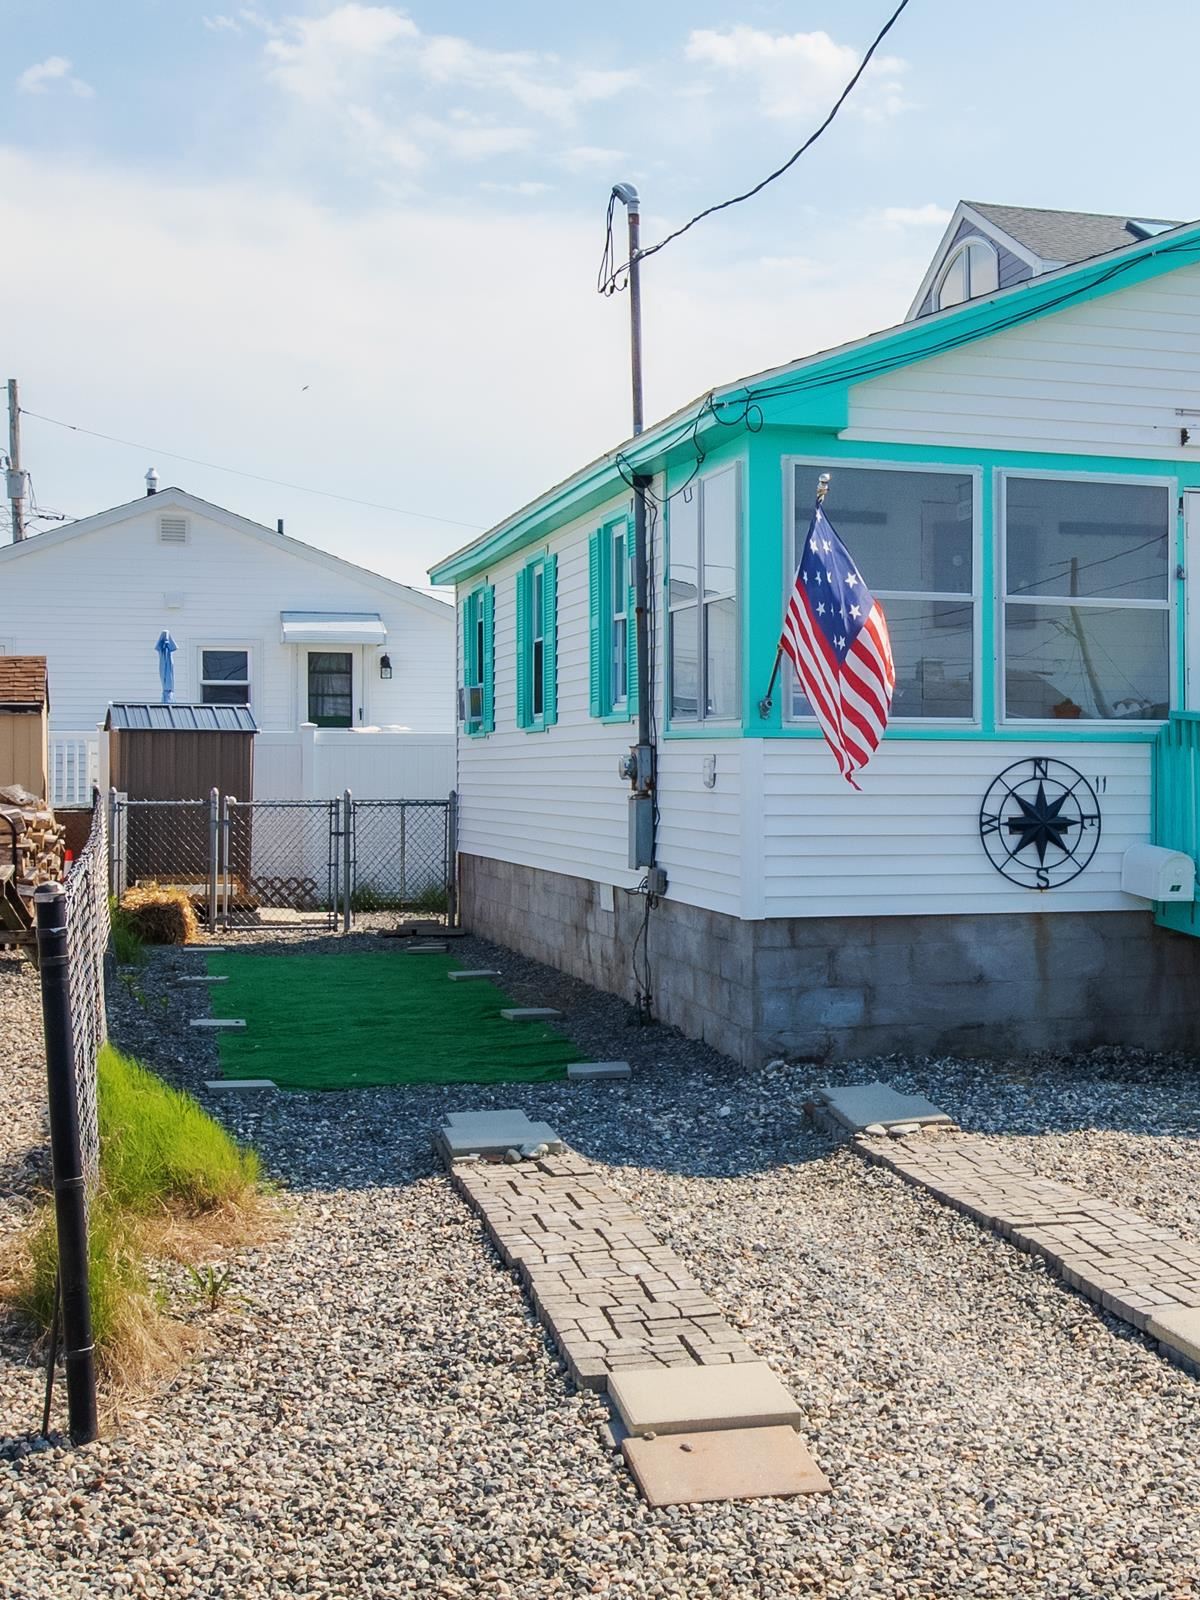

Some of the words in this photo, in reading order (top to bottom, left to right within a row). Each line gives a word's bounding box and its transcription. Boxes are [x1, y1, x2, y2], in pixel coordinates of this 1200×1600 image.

[1033, 757, 1049, 779] N
[1095, 775, 1107, 794] 11
[980, 811, 1000, 835] W
[1081, 814, 1101, 830] E
[1036, 867, 1050, 890] S
